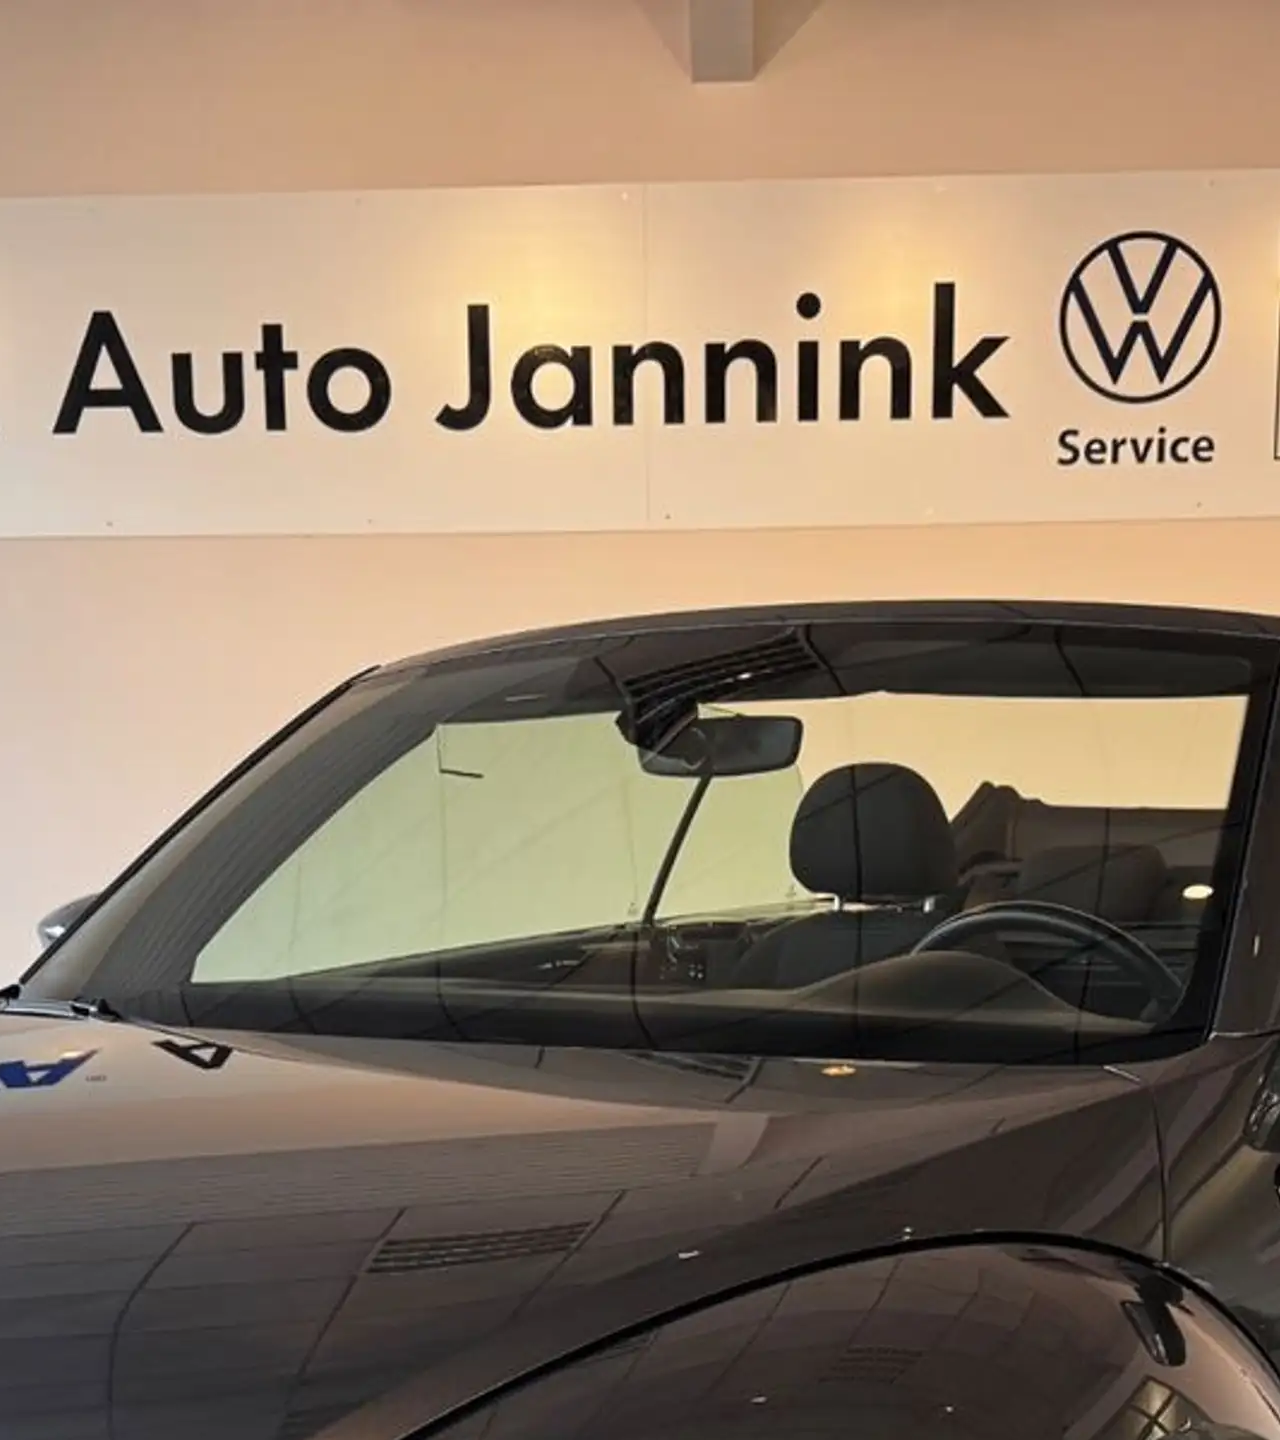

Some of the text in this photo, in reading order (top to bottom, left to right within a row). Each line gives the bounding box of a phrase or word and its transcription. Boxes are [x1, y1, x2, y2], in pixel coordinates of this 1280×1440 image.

[53, 282, 1012, 435] Auto Jannink
[1056, 427, 1216, 467] Service
